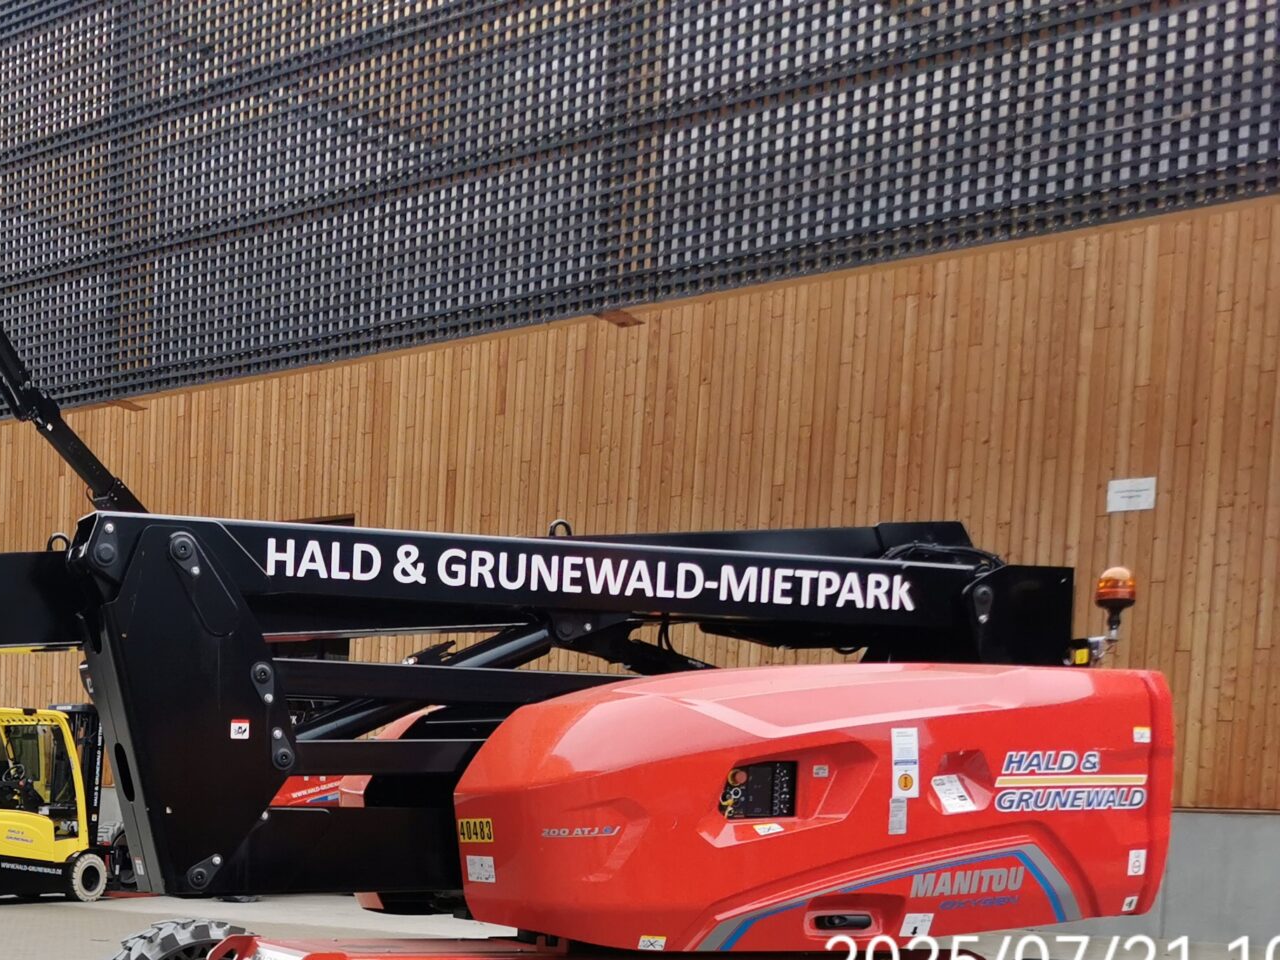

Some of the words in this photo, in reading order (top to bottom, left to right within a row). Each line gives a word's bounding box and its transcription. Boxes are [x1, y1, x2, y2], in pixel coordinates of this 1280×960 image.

[267, 538, 381, 582] HALD
[393, 543, 426, 584] &
[437, 548, 915, 611] GRUNEWALD-MIETPARK
[1002, 751, 1077, 774] HALD
[1080, 751, 1101, 772] &
[994, 788, 1147, 812] GRUNEWALD
[460, 820, 493, 841] 40483
[573, 827, 599, 836] ATJ
[910, 866, 1024, 898] MANITOU
